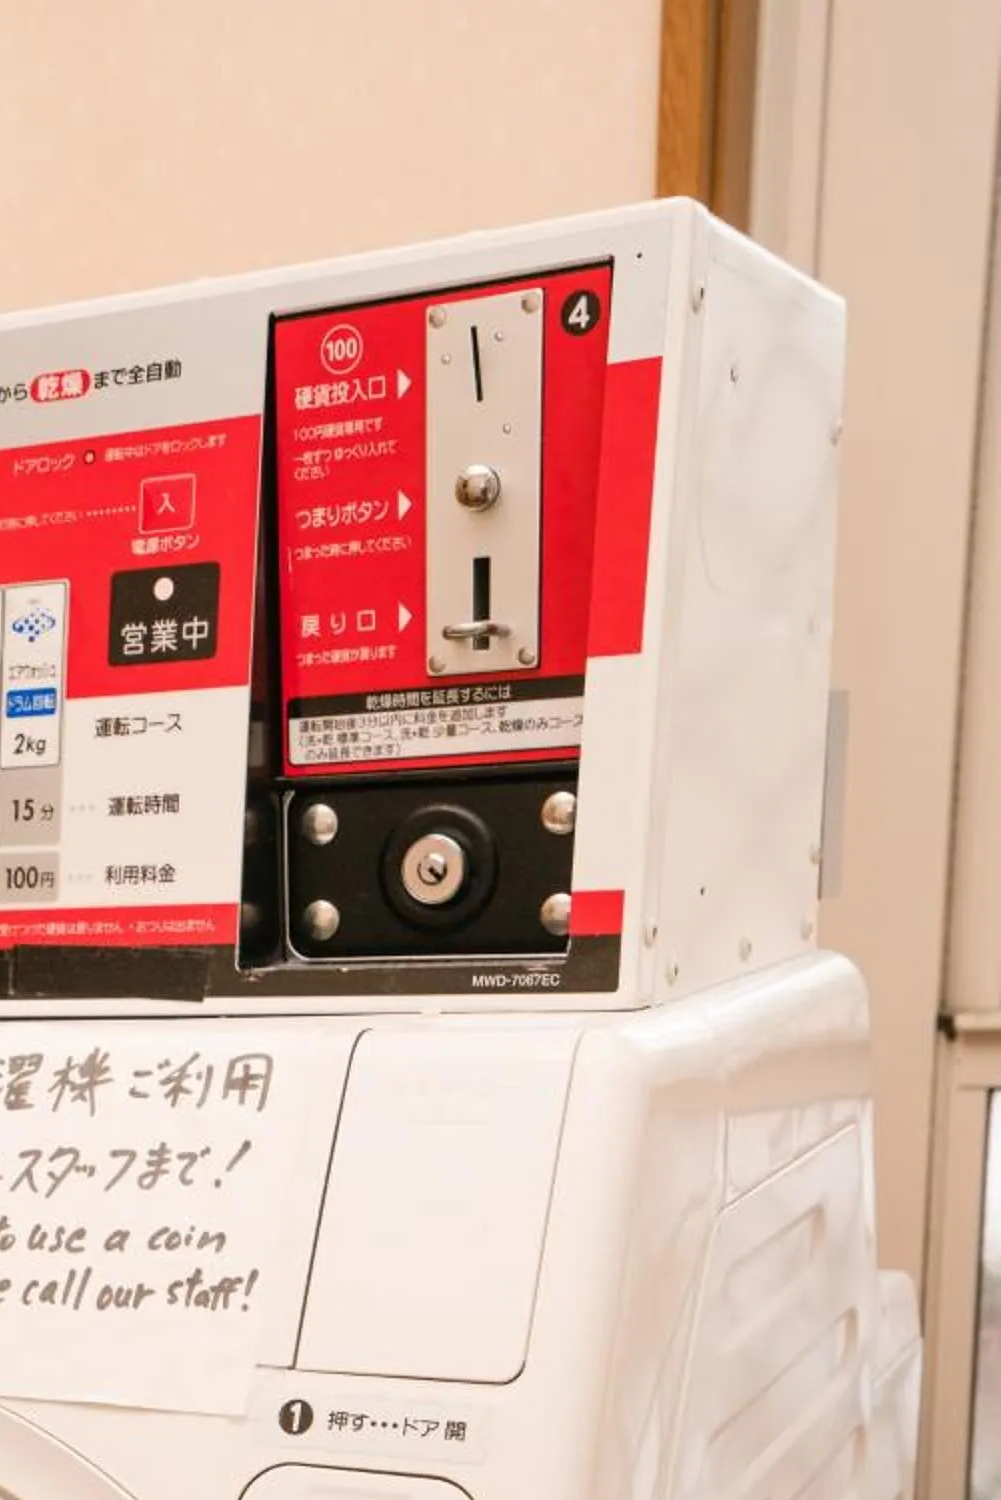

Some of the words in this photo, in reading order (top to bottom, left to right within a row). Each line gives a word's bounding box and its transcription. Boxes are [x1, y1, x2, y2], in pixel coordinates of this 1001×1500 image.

[565, 292, 594, 331] 4
[325, 337, 358, 361] 100
[295, 376, 387, 410] 硬貨投入口
[13, 453, 75, 475] ドアロック
[157, 492, 176, 514] 入
[295, 500, 390, 529] つまりボタン
[120, 615, 210, 656] 営業中
[300, 608, 377, 639] 戻り口
[94, 711, 183, 739] 運転コース
[13, 733, 47, 755] 2kg
[11, 797, 55, 821] 15分
[107, 792, 181, 817] 運転時間
[5, 865, 56, 889] 100円
[104, 864, 178, 886] 利用料金
[27, 1224, 87, 1253] use
[103, 1225, 130, 1253] a
[146, 1224, 227, 1253] coin
[22, 1266, 92, 1311] call
[97, 1282, 154, 1311] our
